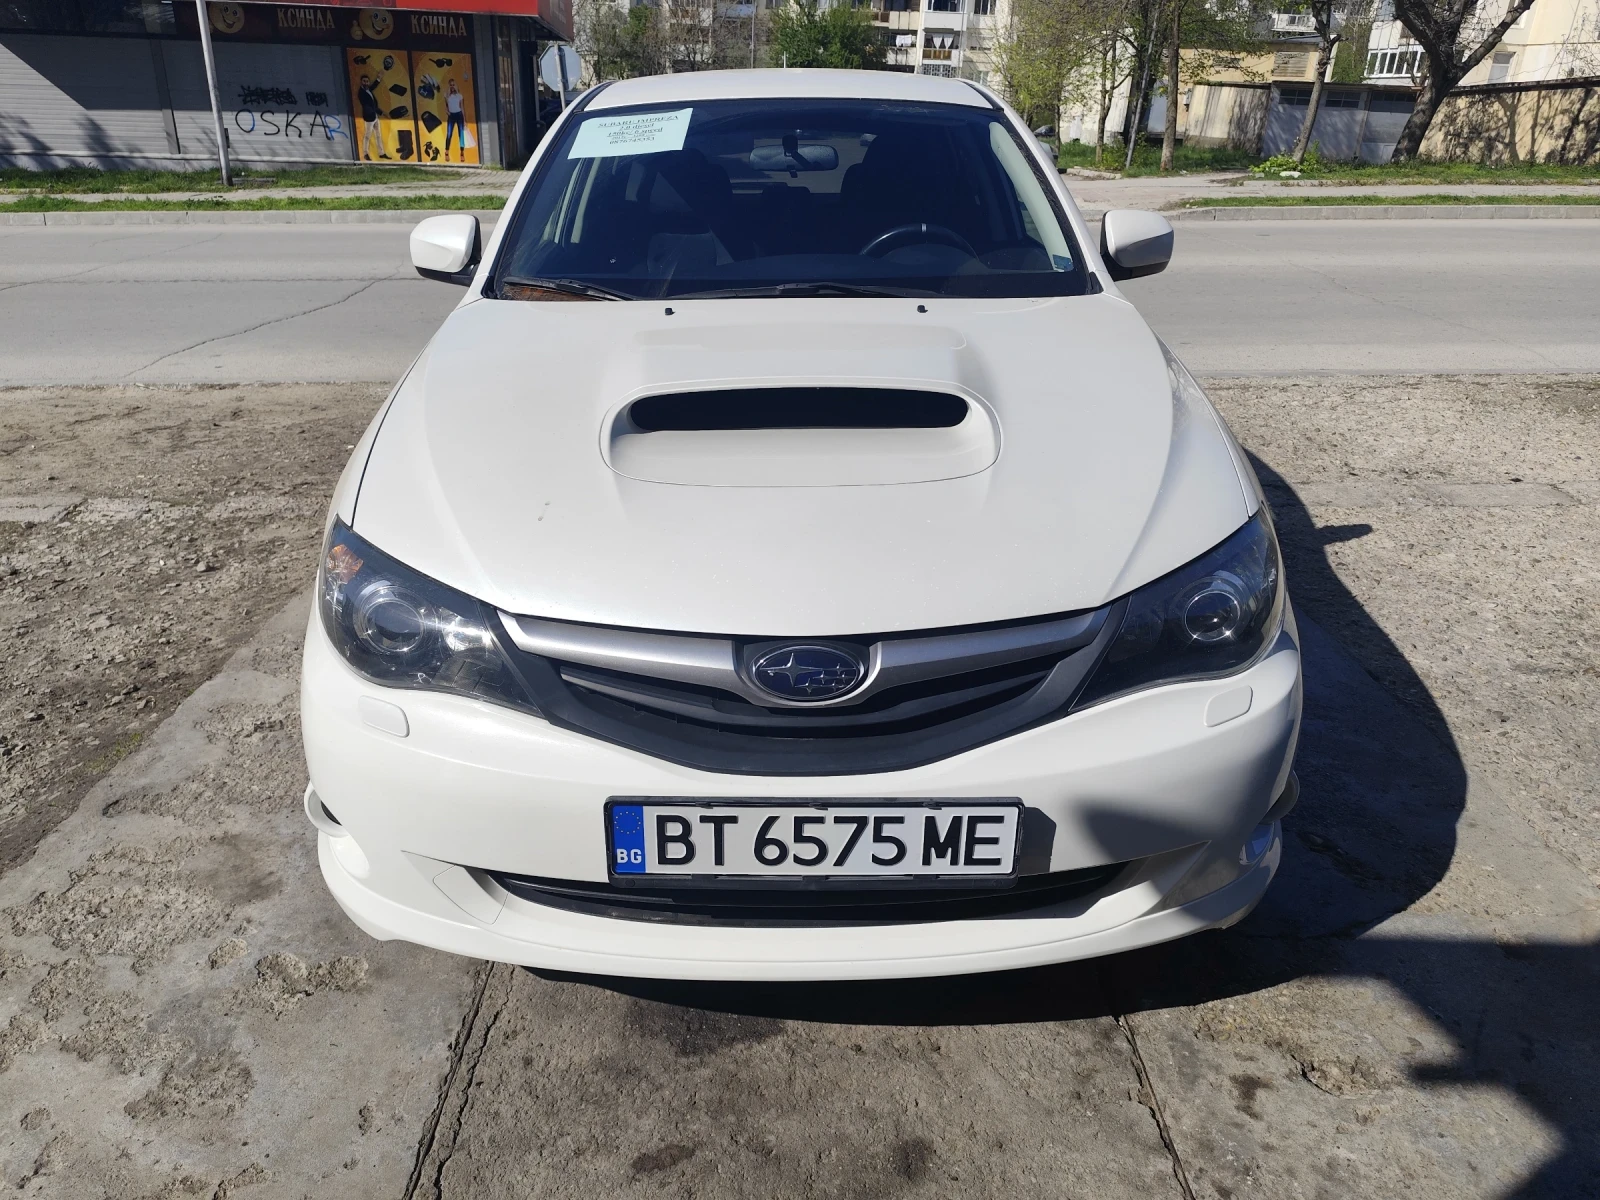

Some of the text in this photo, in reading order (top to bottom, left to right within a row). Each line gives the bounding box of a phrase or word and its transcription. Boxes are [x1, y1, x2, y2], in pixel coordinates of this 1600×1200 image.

[277, 8, 335, 29] КСИНДА
[411, 15, 466, 38] КСИНДА
[235, 109, 348, 141] OSKAR
[637, 115, 679, 123] IMPREZA
[656, 814, 1005, 867] BT 6575 ME
[617, 848, 643, 864] BG
